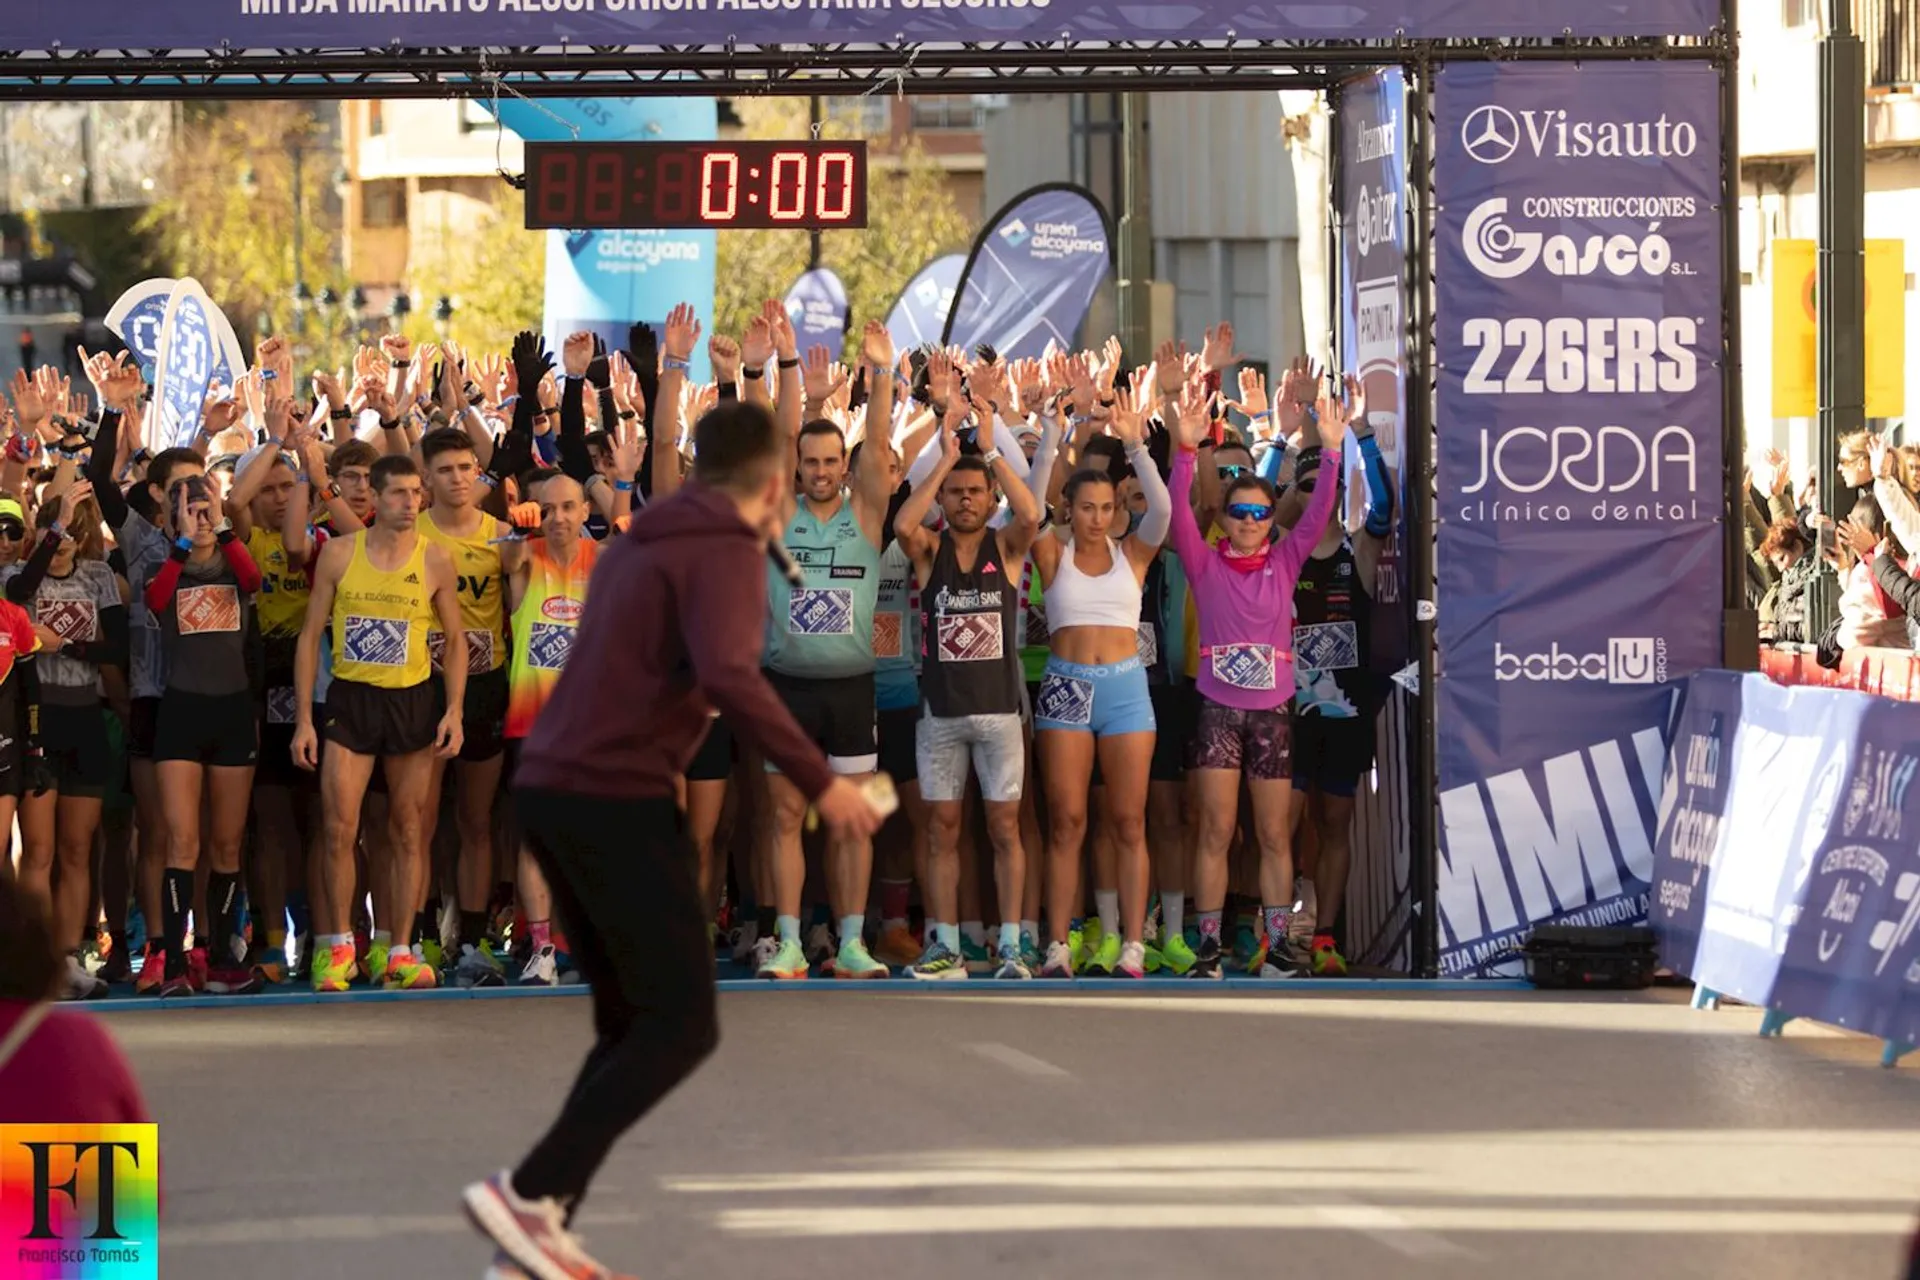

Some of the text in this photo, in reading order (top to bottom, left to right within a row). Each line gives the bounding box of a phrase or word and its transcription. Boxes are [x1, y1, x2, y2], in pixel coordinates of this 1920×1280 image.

[1520, 109, 1697, 157] Visauto
[700, 151, 854, 220] 0:00
[1523, 197, 1696, 218] CONSTRUCCIONES
[597, 237, 700, 263] alcoyana
[1671, 262, 1697, 275] S.L.
[1462, 317, 1697, 394] 226ERS
[1461, 426, 1696, 493] JORDA
[1461, 500, 1697, 521] clínica dental
[53, 612, 74, 635] 679
[542, 634, 569, 660] 2213
[1656, 637, 1667, 683] GROUP
[1227, 654, 1252, 679] 2135
[1046, 688, 1070, 711] 2215
[1587, 896, 1638, 927] UNIÓN
